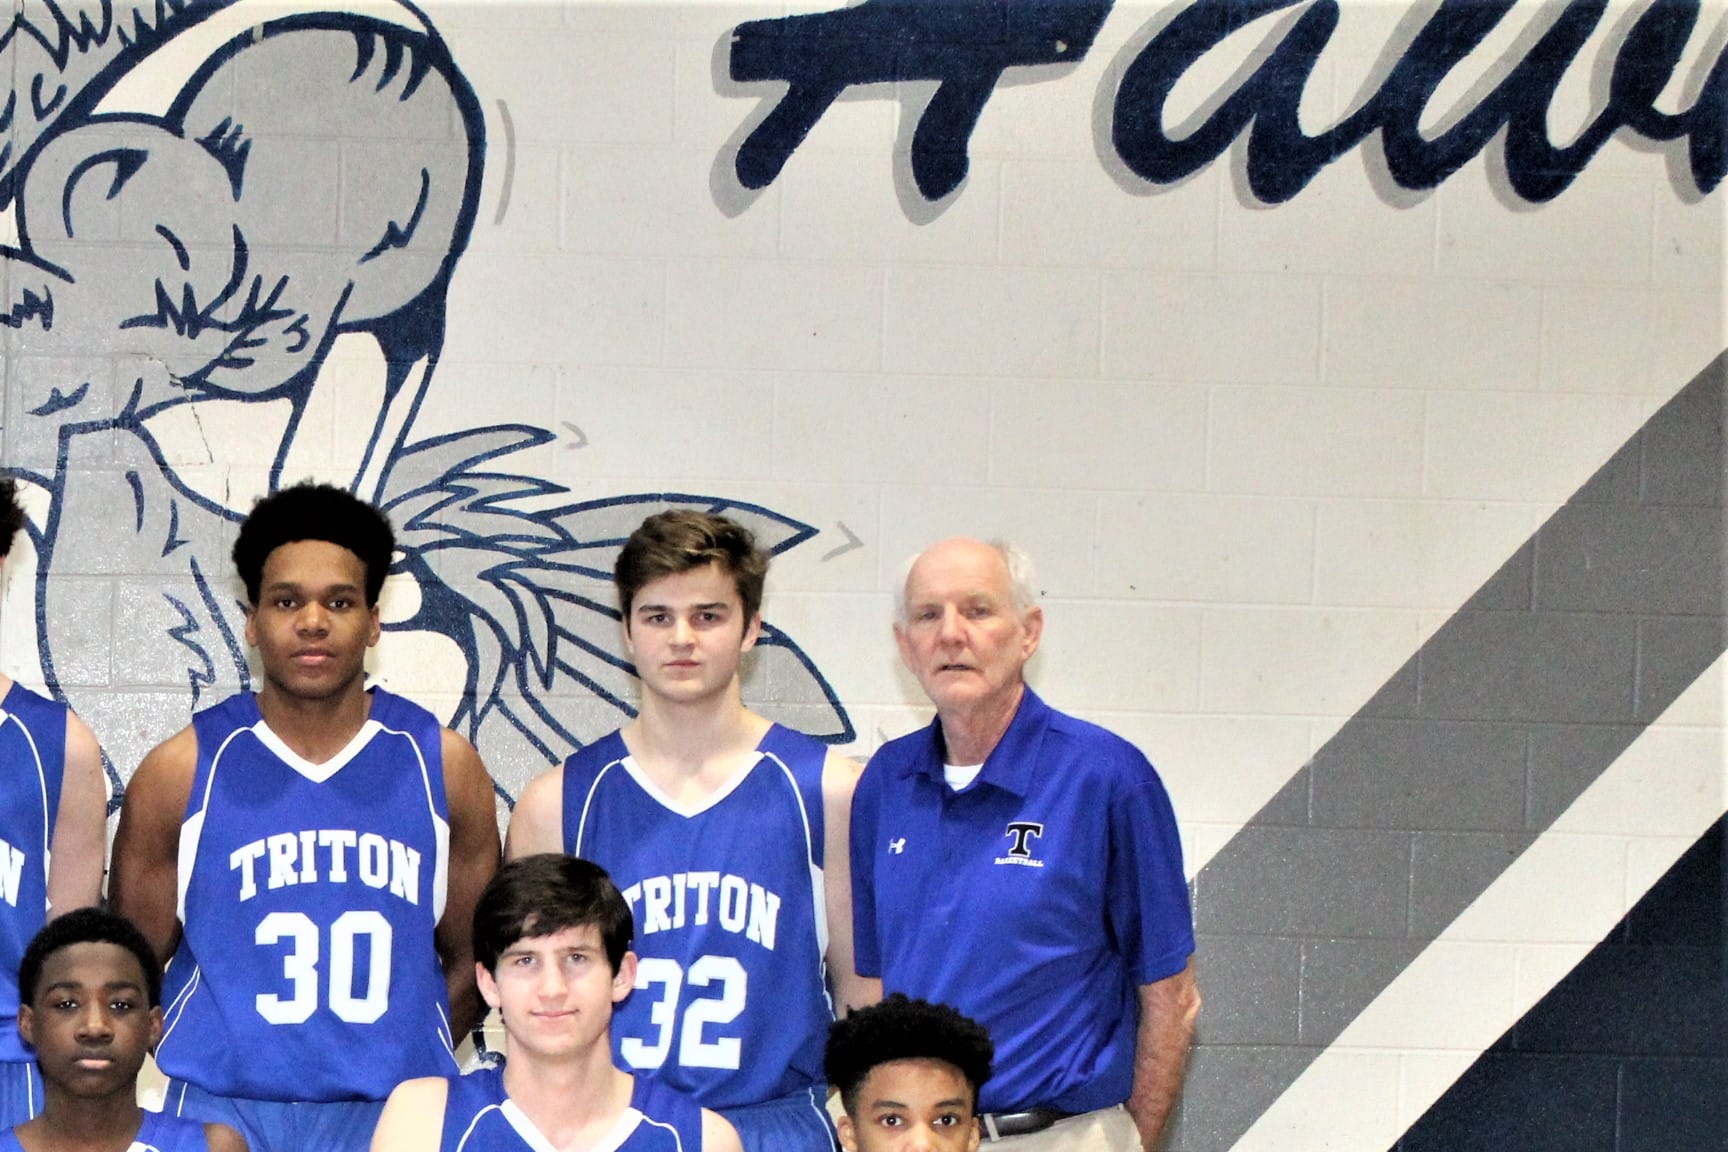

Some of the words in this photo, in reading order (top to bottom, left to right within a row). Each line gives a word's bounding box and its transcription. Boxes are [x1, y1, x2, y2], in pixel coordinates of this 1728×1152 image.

[230, 830, 420, 905] TRITON
[1005, 821, 1044, 857] T
[256, 911, 392, 1024] 30
[620, 954, 748, 1070] 32
